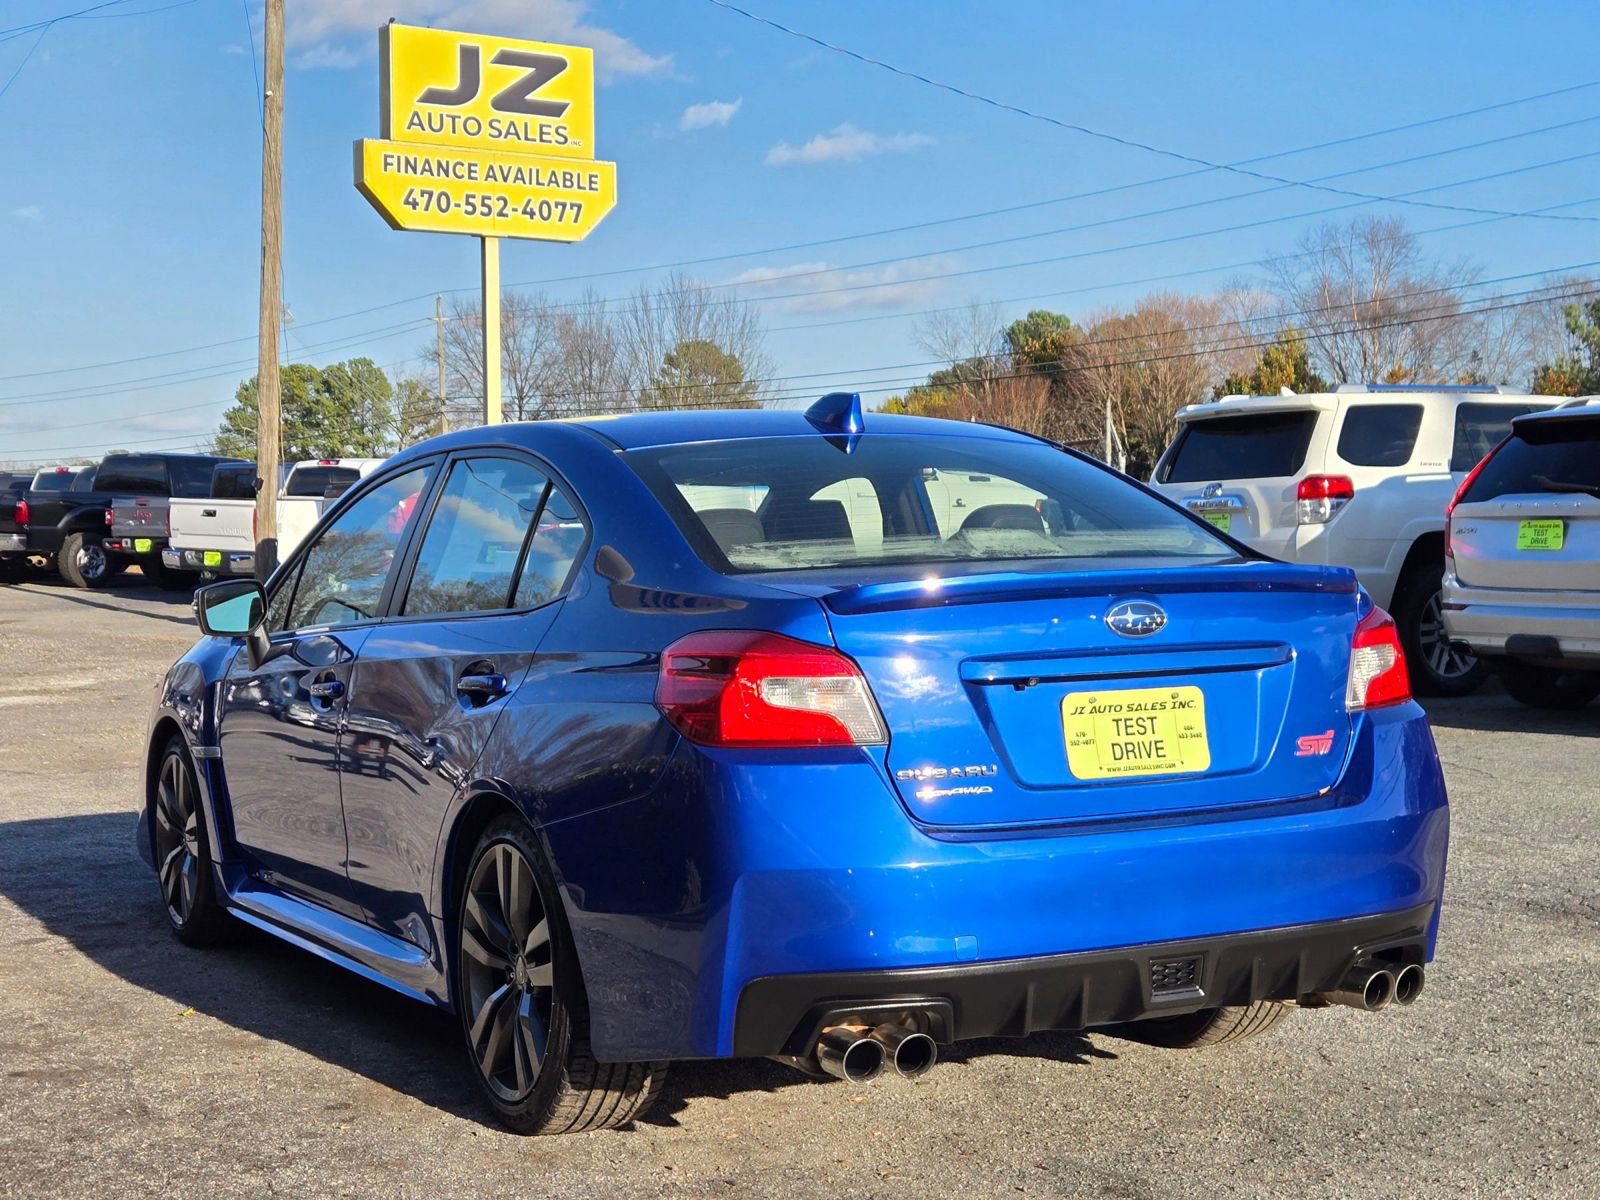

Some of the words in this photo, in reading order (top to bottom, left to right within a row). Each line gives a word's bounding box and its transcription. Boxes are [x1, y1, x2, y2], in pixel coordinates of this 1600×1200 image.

[416, 44, 571, 118] JZ
[406, 110, 482, 136] AUTO
[488, 119, 569, 145] SALES
[383, 154, 478, 181] FINANCE
[484, 164, 599, 192] AVAILABLE
[403, 188, 583, 224] 470-552-4077
[1530, 537, 1548, 545] DRIVE
[1533, 529, 1549, 537] TEST
[1070, 705, 1086, 716] JZ
[1089, 703, 1123, 714] AUTO
[1126, 701, 1167, 712] SALES
[1111, 716, 1158, 737] TEST
[1111, 740, 1167, 761] DRIVE
[896, 765, 998, 781] SUBARU
